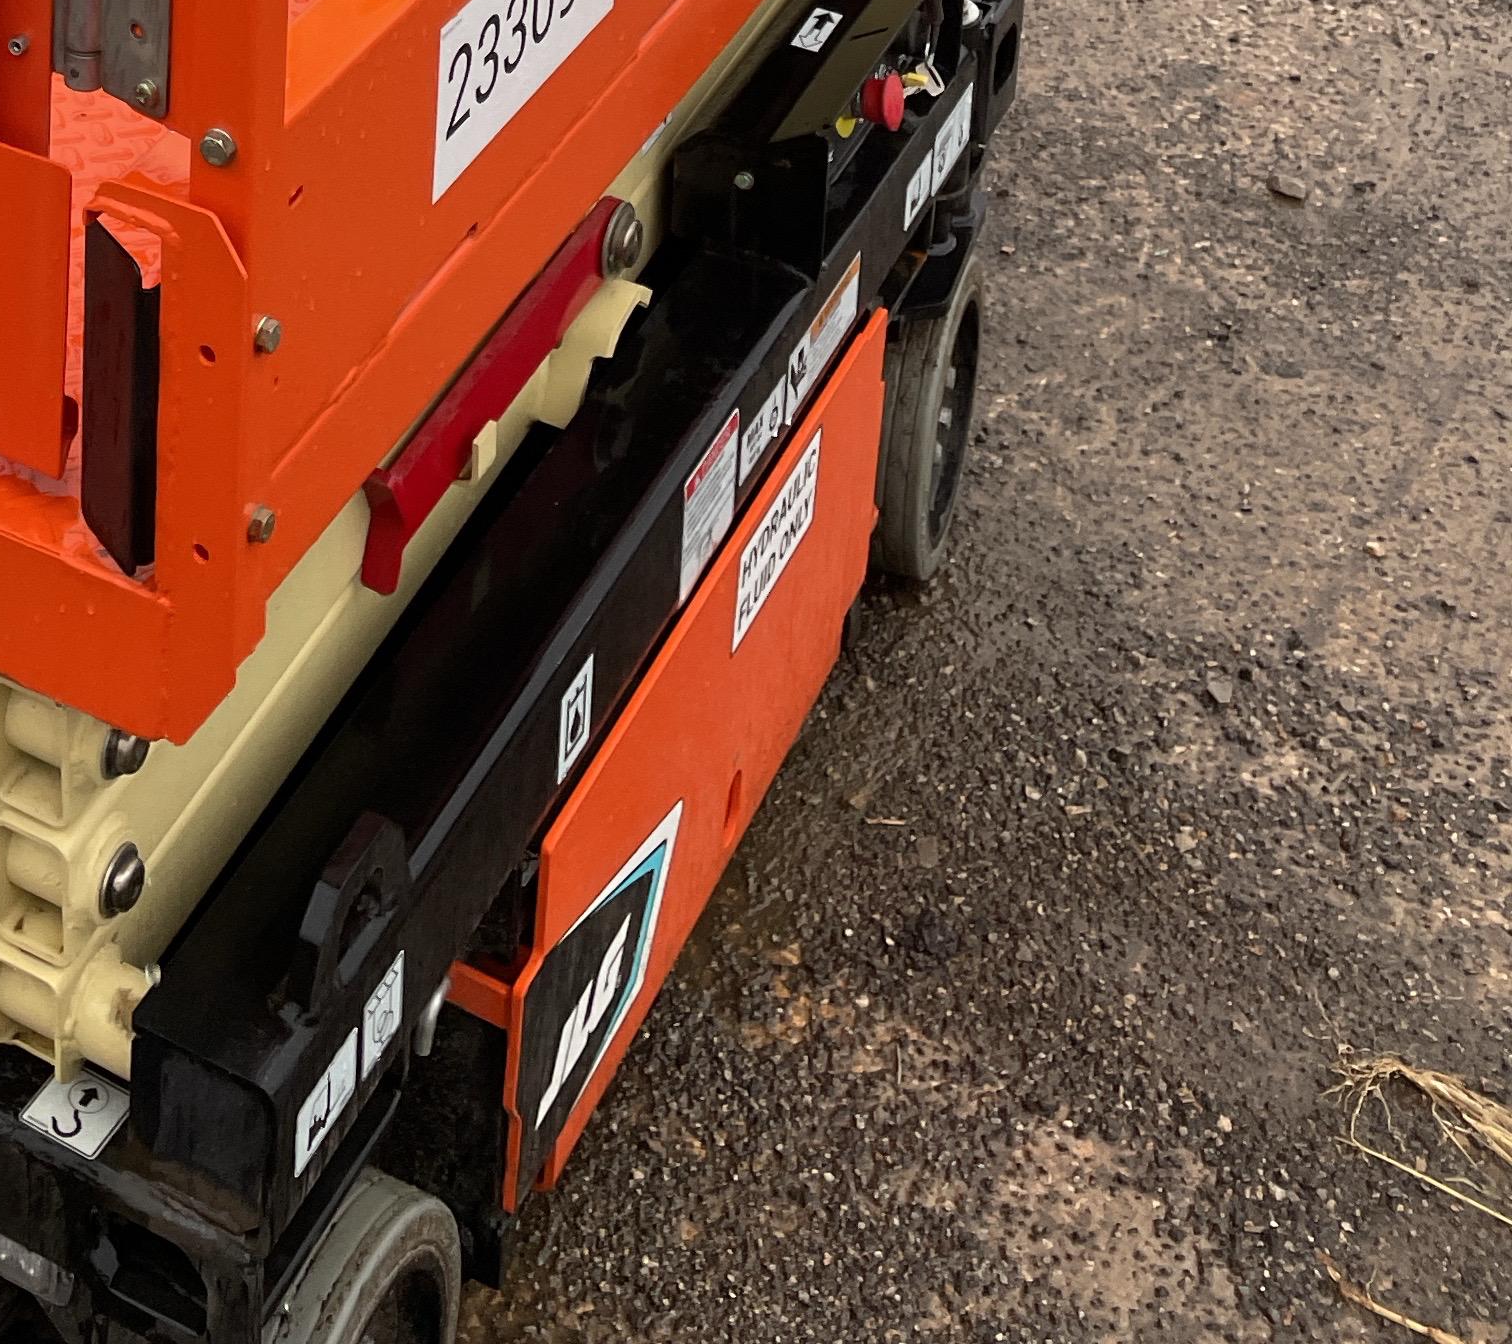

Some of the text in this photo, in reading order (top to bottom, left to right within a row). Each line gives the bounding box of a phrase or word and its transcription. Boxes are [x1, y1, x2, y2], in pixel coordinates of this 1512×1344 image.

[737, 488, 814, 633] FLUID ONLY
[741, 448, 817, 589] HYDRAULIC
